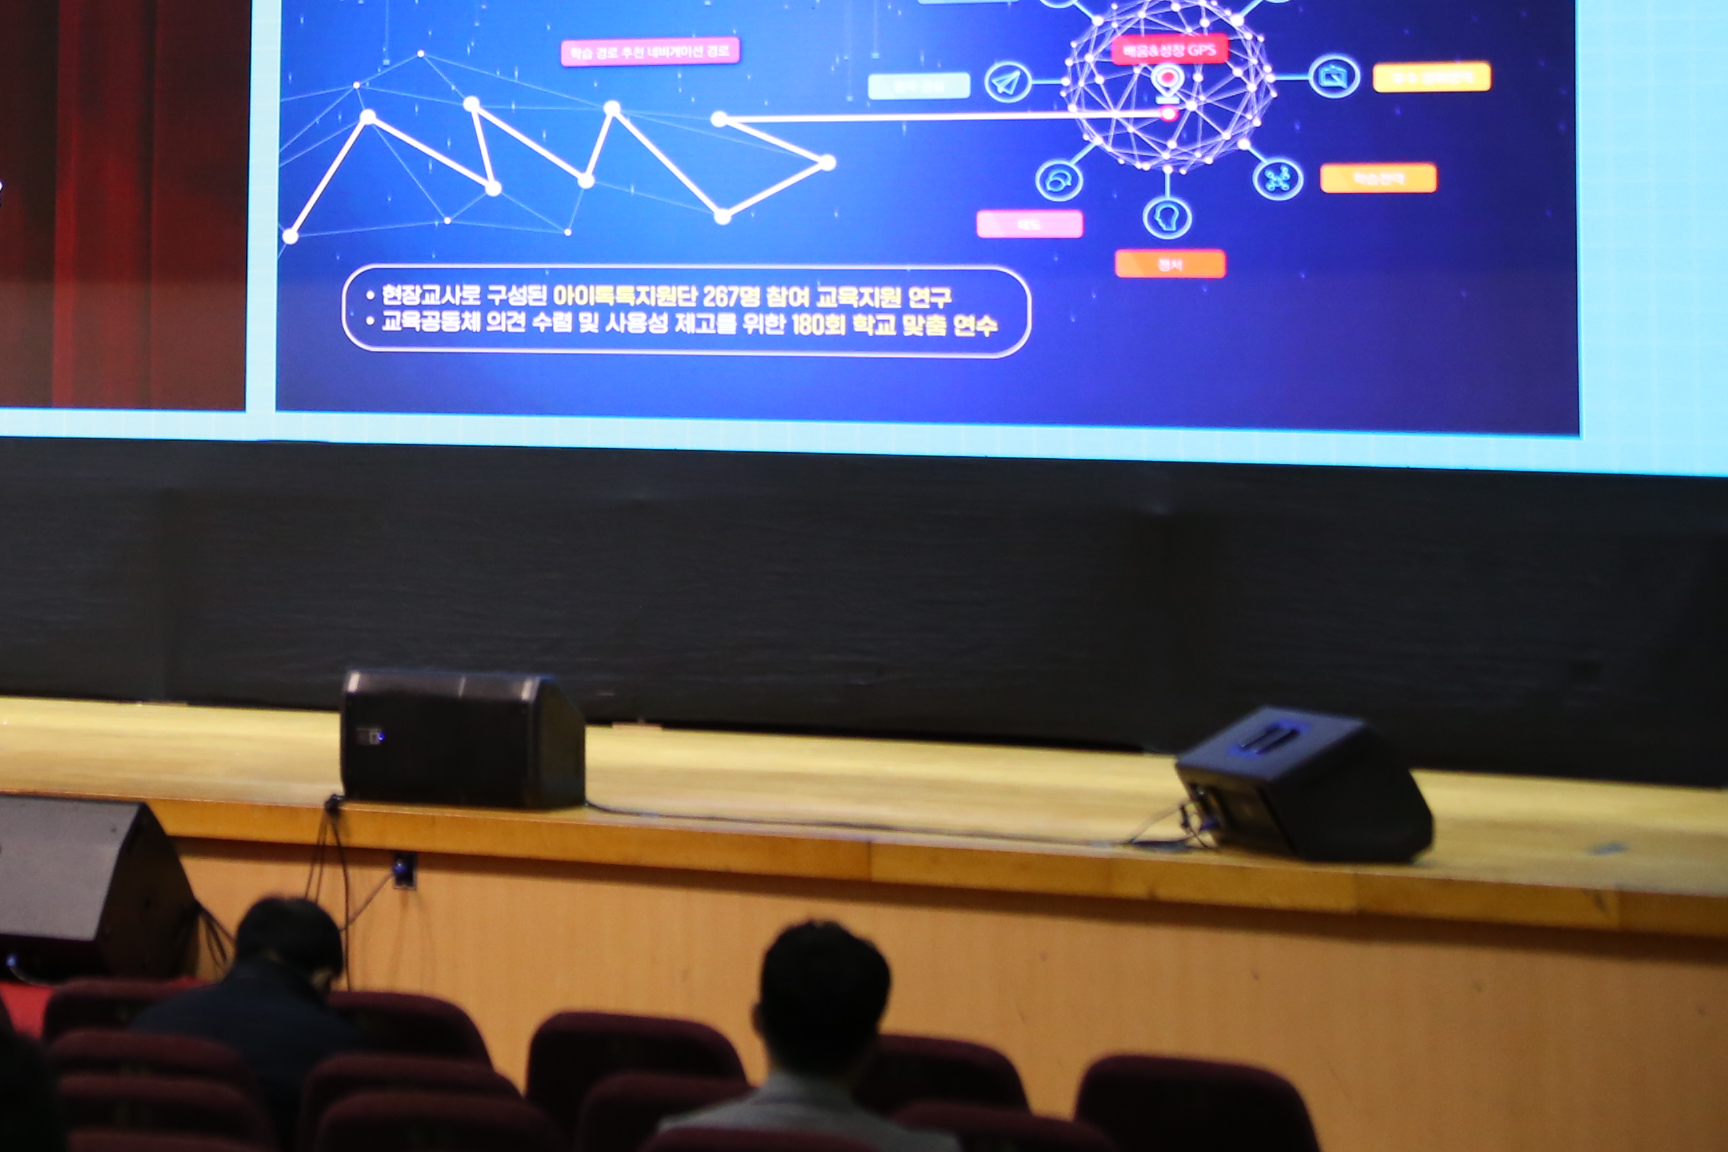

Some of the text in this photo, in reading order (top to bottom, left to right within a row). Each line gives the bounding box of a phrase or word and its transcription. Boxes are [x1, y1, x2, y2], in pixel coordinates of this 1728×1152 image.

[1187, 43, 1217, 57] GPS
[381, 284, 953, 310] 현장교사로 구성된 아이톡톡지원단 267명 참여 교육지원 연구
[381, 311, 999, 338] 교육공동체 의견 수렴 및 사용성 제고를 위한 180회 학교 맞춤 연수
